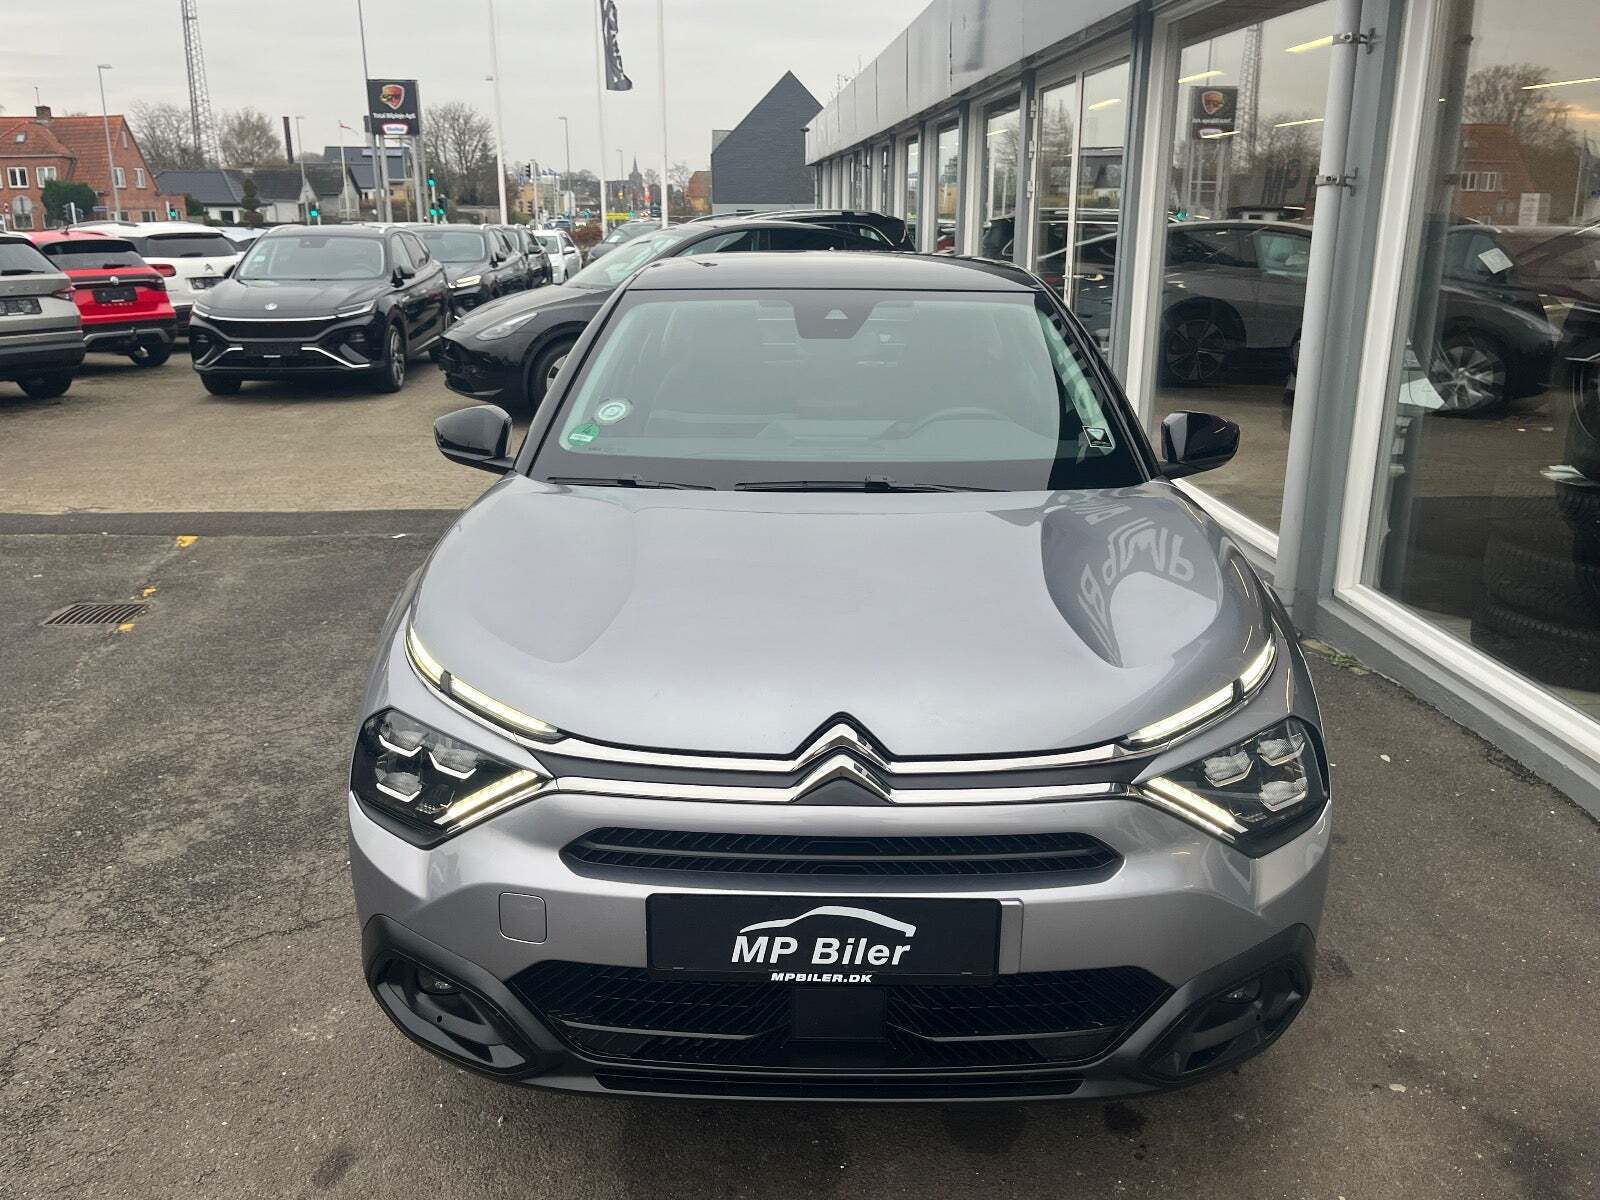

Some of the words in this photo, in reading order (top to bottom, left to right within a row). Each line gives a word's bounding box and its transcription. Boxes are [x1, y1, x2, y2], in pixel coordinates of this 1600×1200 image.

[731, 935, 798, 963] MP
[811, 937, 911, 966] Biler
[770, 972, 872, 983] MPBILER.DK
